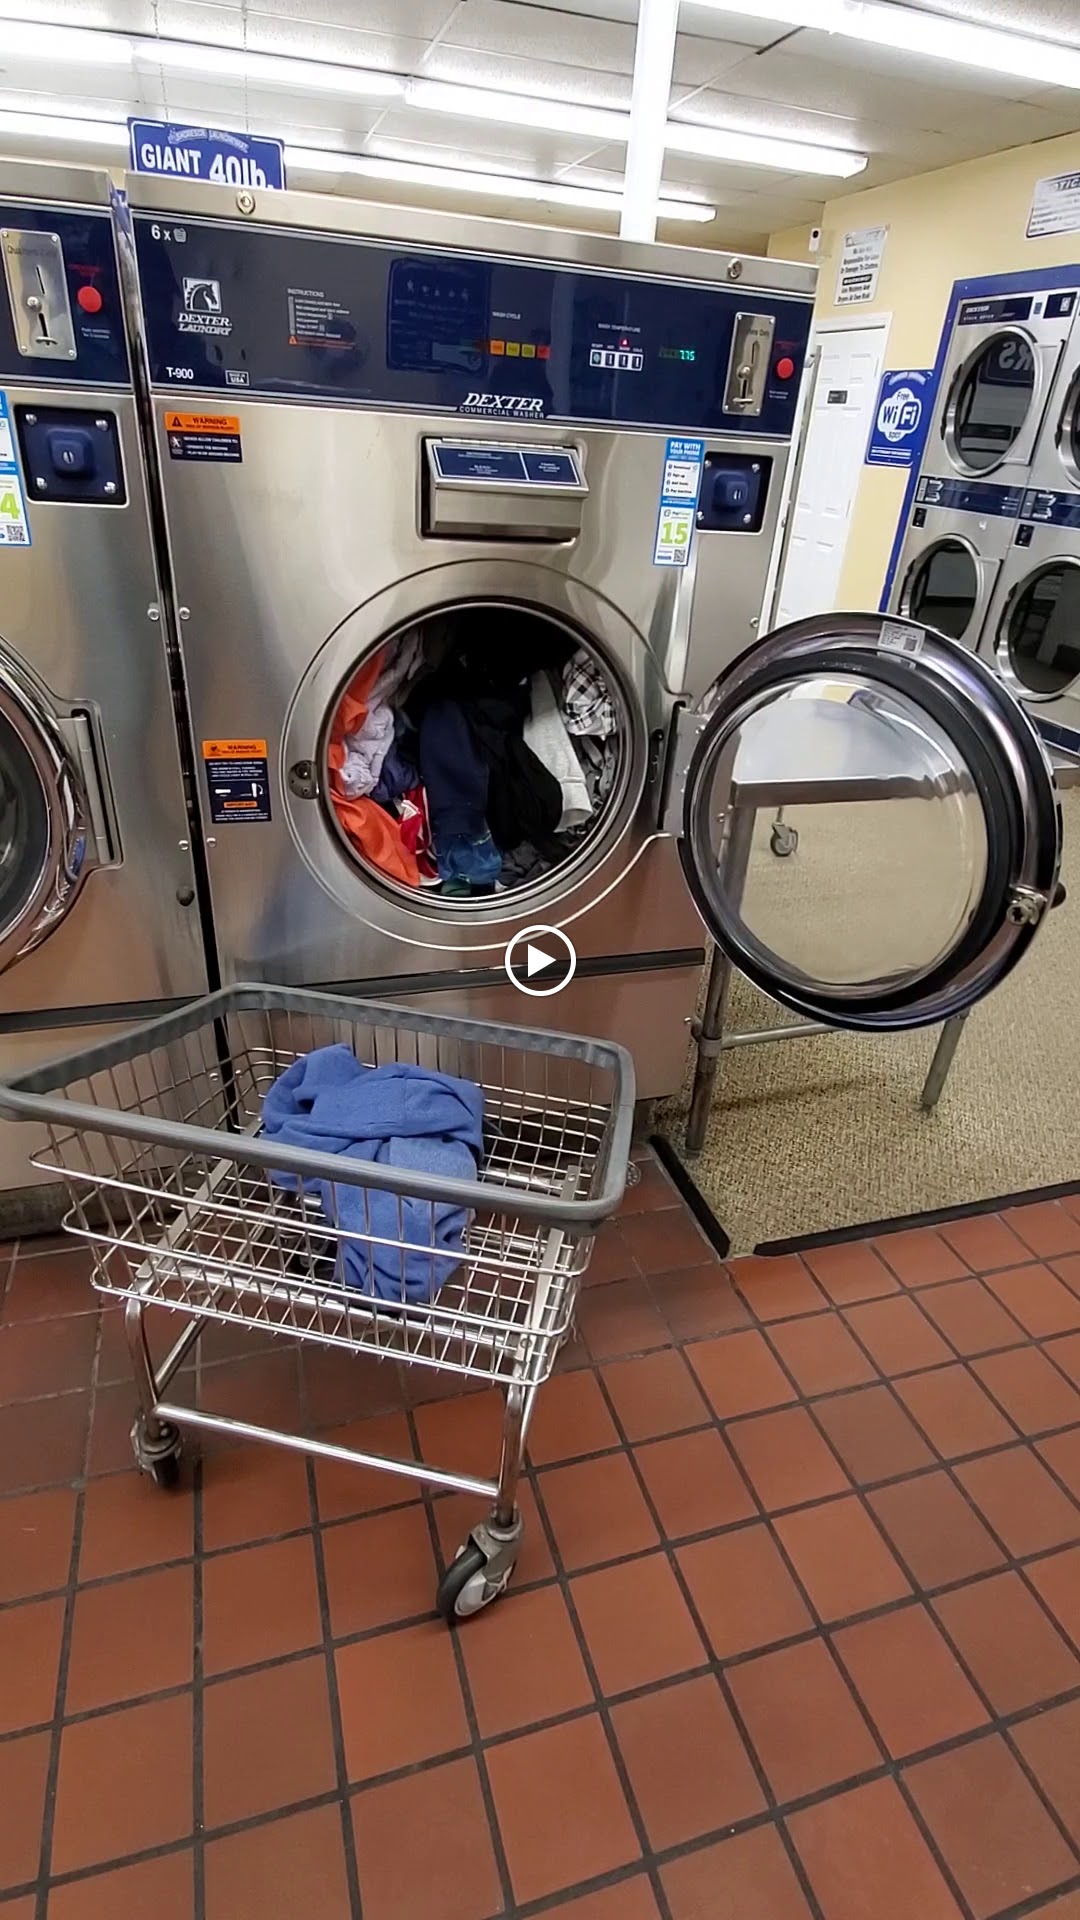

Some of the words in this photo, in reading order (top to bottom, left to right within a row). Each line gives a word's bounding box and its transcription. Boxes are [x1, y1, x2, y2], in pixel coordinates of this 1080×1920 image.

[141, 143, 201, 175] GIANT
[151, 224, 161, 240] 6
[163, 230, 171, 241] x
[287, 288, 325, 298] INSTRUCTIONS
[178, 312, 231, 326] DEXTER
[506, 312, 521, 320] CYCLE
[178, 323, 232, 336] LAUNDRY
[166, 366, 194, 379] T-900
[463, 392, 544, 412] DEXTER
[896, 391, 910, 400] Free
[459, 406, 510, 416] COMMERCIAL
[513, 409, 545, 419] WASHER
[192, 416, 228, 425] WARNING
[670, 441, 683, 449] PAY
[683, 442, 701, 450] WITH
[660, 522, 688, 544] 15
